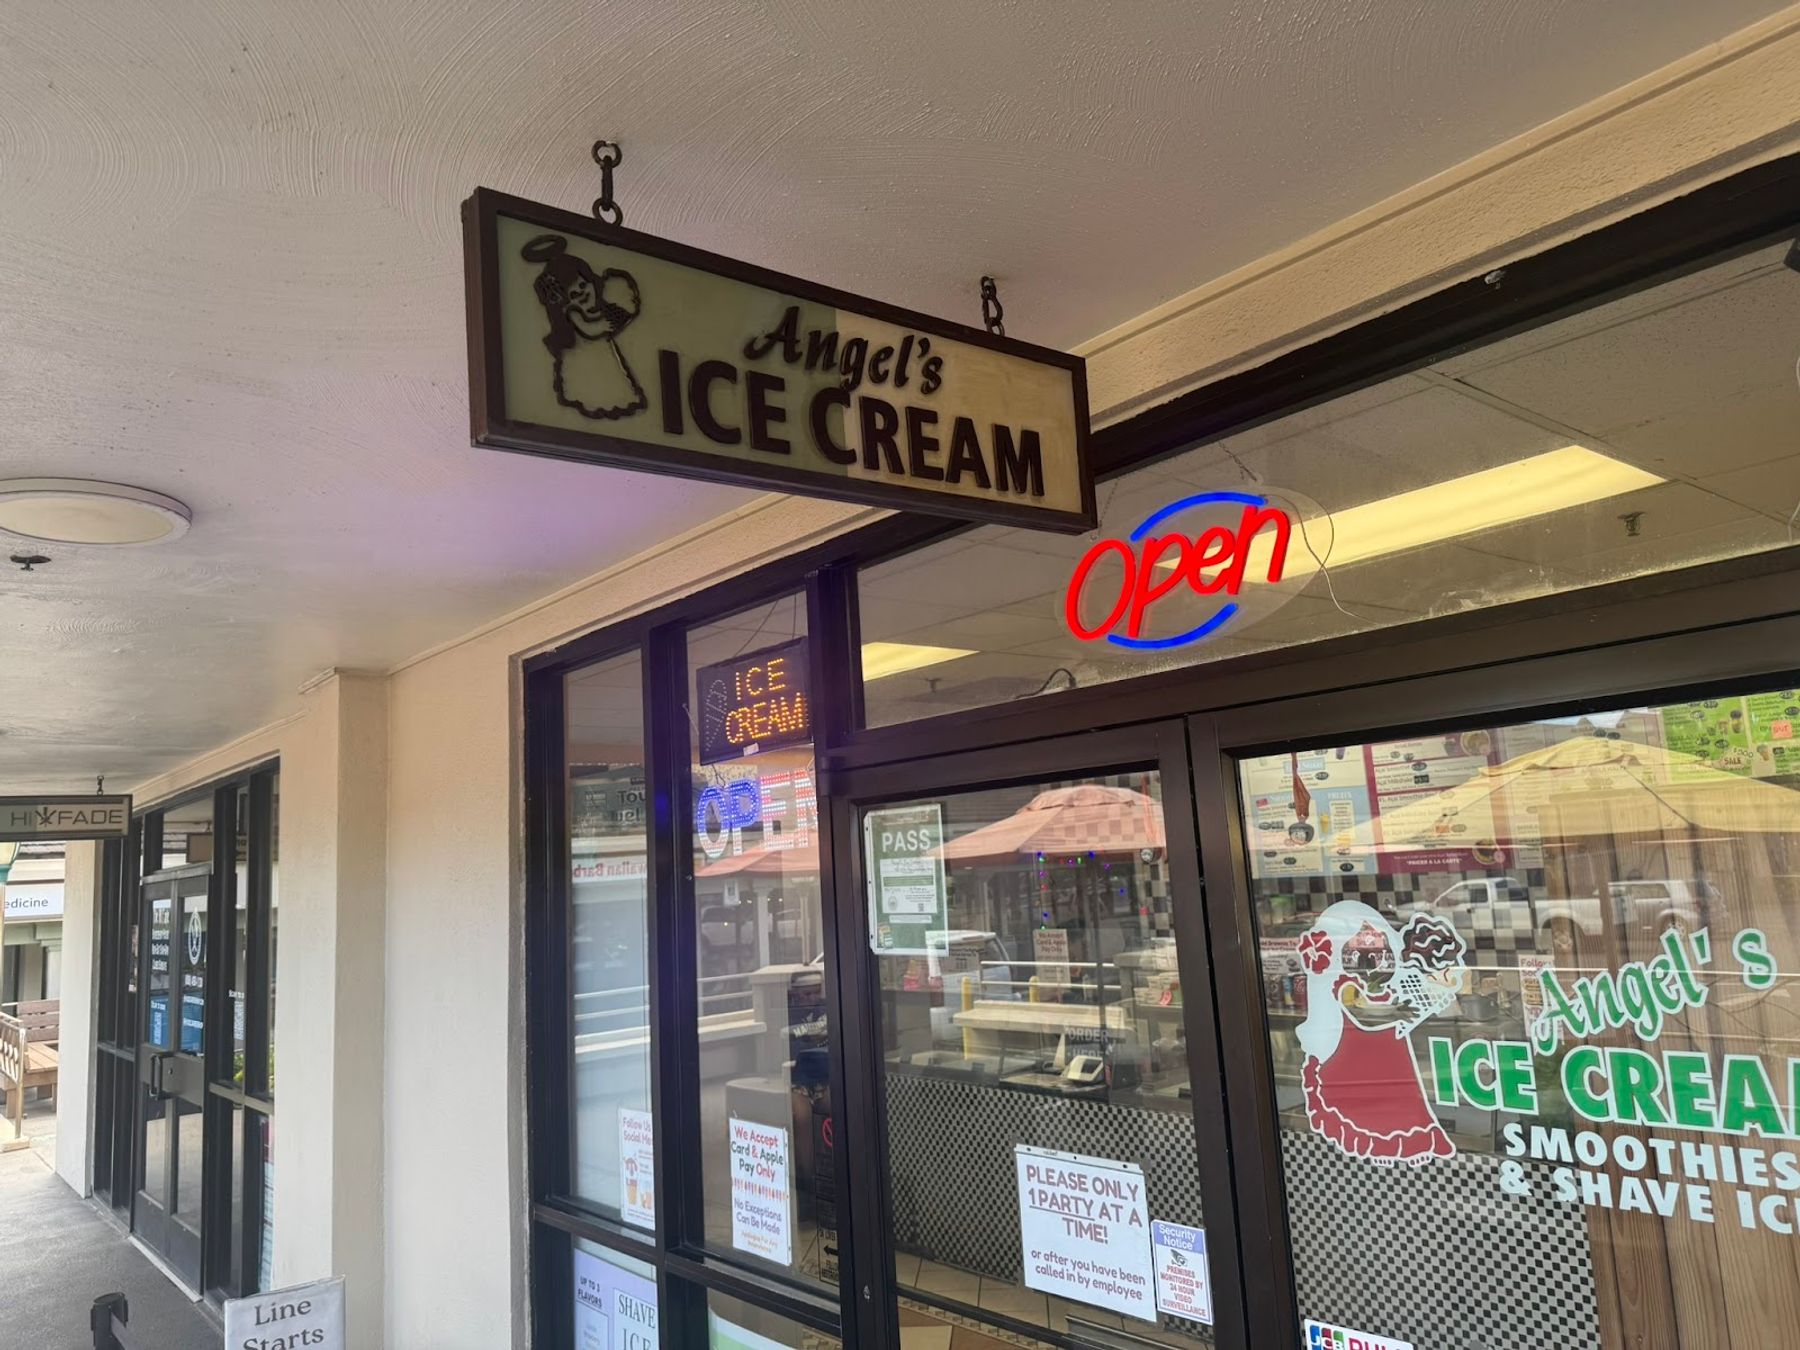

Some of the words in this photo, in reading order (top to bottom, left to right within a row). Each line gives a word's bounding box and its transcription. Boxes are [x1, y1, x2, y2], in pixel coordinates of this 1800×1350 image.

[743, 306, 944, 394] Angel's
[659, 349, 792, 455] ICE
[808, 387, 1045, 497] CREAM
[1065, 505, 1292, 641] Open
[735, 657, 786, 701] ICE
[725, 692, 804, 744] CREAM
[697, 768, 818, 858] OPEN
[882, 829, 931, 852] PASS
[1533, 927, 1778, 1056] Angel's
[1068, 1027, 1109, 1042] ORDER
[1428, 1036, 1540, 1116] ICE
[1561, 1044, 1800, 1140] CREA
[732, 1140, 750, 1157] Card
[760, 1148, 784, 1166] Apple
[735, 1125, 748, 1140] We
[749, 1131, 778, 1149] Accept
[739, 1159, 755, 1177] Pay
[756, 1163, 776, 1183] Only
[1503, 1122, 1800, 1191] SMOOTHIES
[1026, 1164, 1089, 1193] PLEASE
[1092, 1176, 1139, 1202] ONLY
[1499, 1160, 1532, 1197] &
[1552, 1166, 1716, 1223] SHAVE
[1736, 1189, 1800, 1235] IC
[734, 1197, 744, 1211] No
[745, 1200, 782, 1222] Exceptions
[736, 1212, 750, 1226] Can
[760, 1219, 781, 1235] Made
[1099, 1202, 1124, 1223] AT
[1128, 1207, 1143, 1228] A
[1062, 1217, 1109, 1244] TIME!
[1158, 1223, 1196, 1243] Security
[1164, 1235, 1193, 1250] Notice
[1031, 1249, 1041, 1259] or
[1043, 1250, 1068, 1266] after
[1070, 1259, 1090, 1271] you
[1092, 1261, 1118, 1278] have
[1119, 1267, 1146, 1286] been
[1035, 1264, 1065, 1279] called
[1066, 1269, 1076, 1281] in
[1077, 1271, 1091, 1289] by
[1092, 1280, 1143, 1300] employee
[255, 1300, 312, 1326] Line
[618, 1294, 656, 1329] SHAVE
